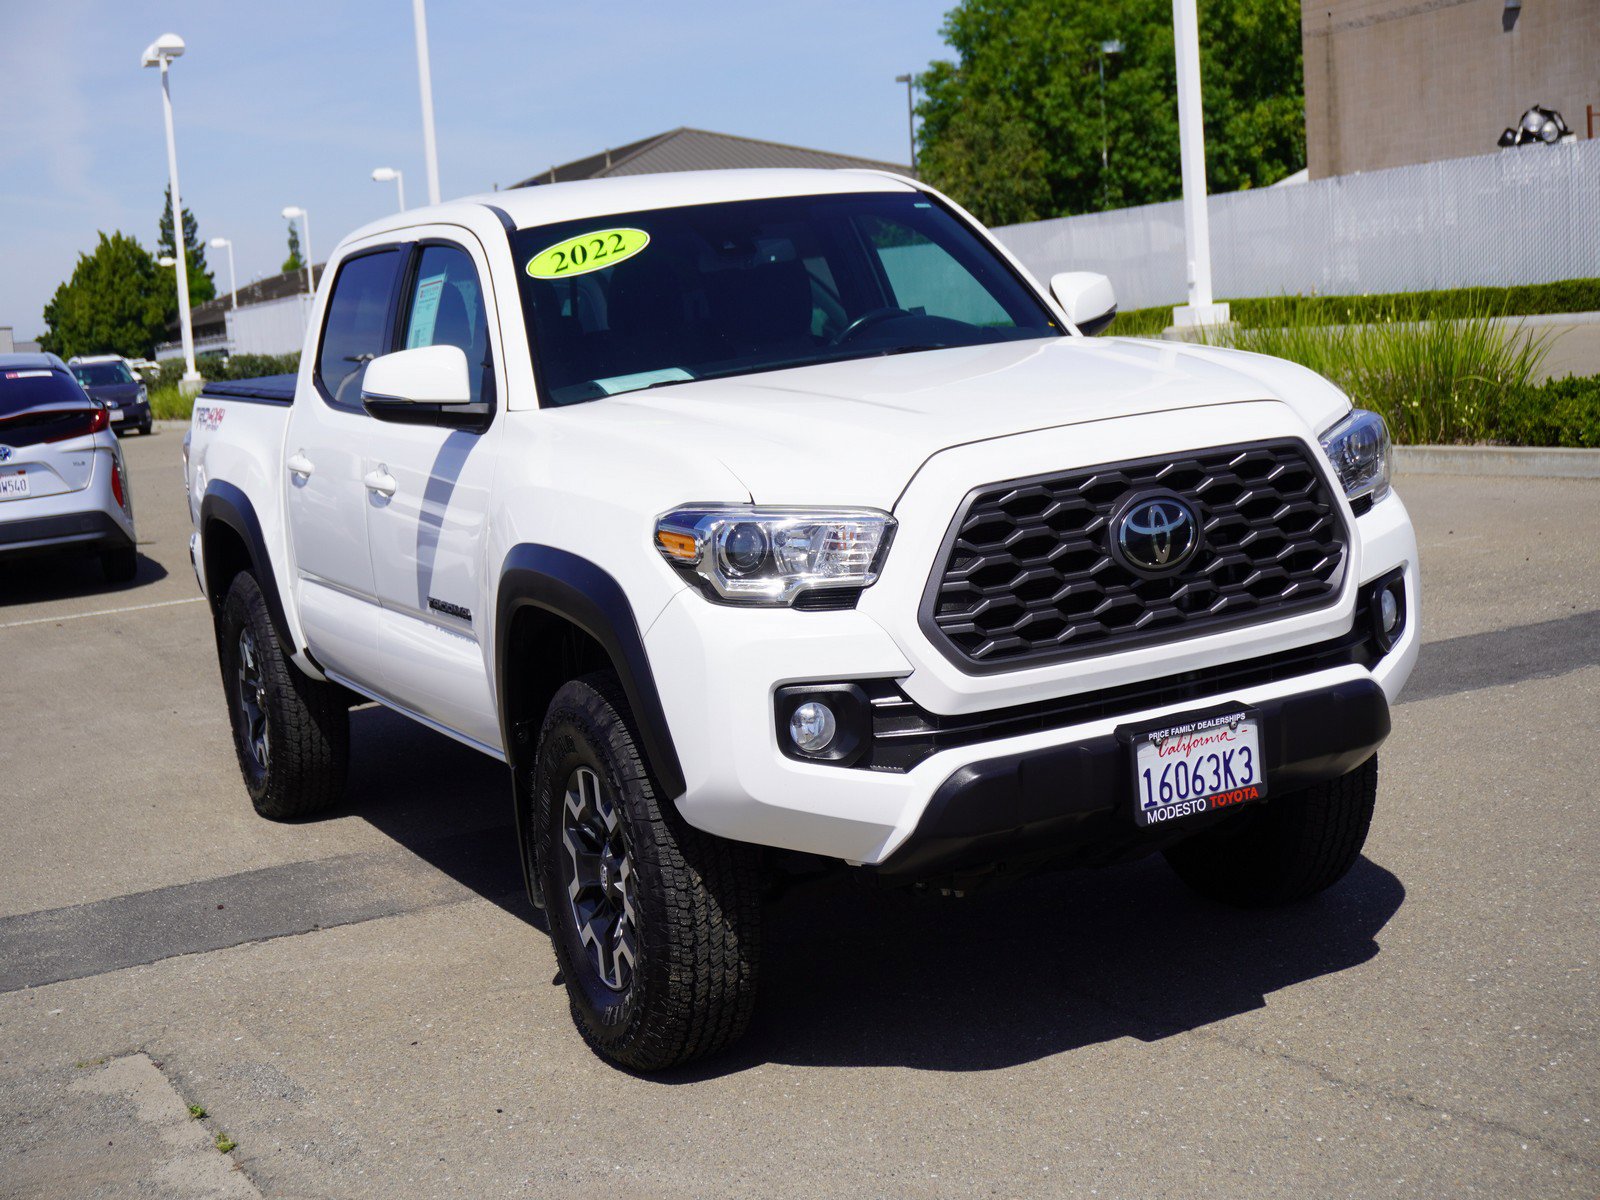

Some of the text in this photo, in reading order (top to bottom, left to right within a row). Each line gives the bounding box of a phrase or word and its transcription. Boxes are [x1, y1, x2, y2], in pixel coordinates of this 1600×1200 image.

[550, 233, 626, 274] 2022
[1149, 713, 1245, 740] PRICE FAMILY DEALERSHIPS
[1159, 731, 1235, 757] California
[1143, 746, 1253, 808] 16063K3
[1148, 787, 1258, 824] MODESTO TOYOTA
